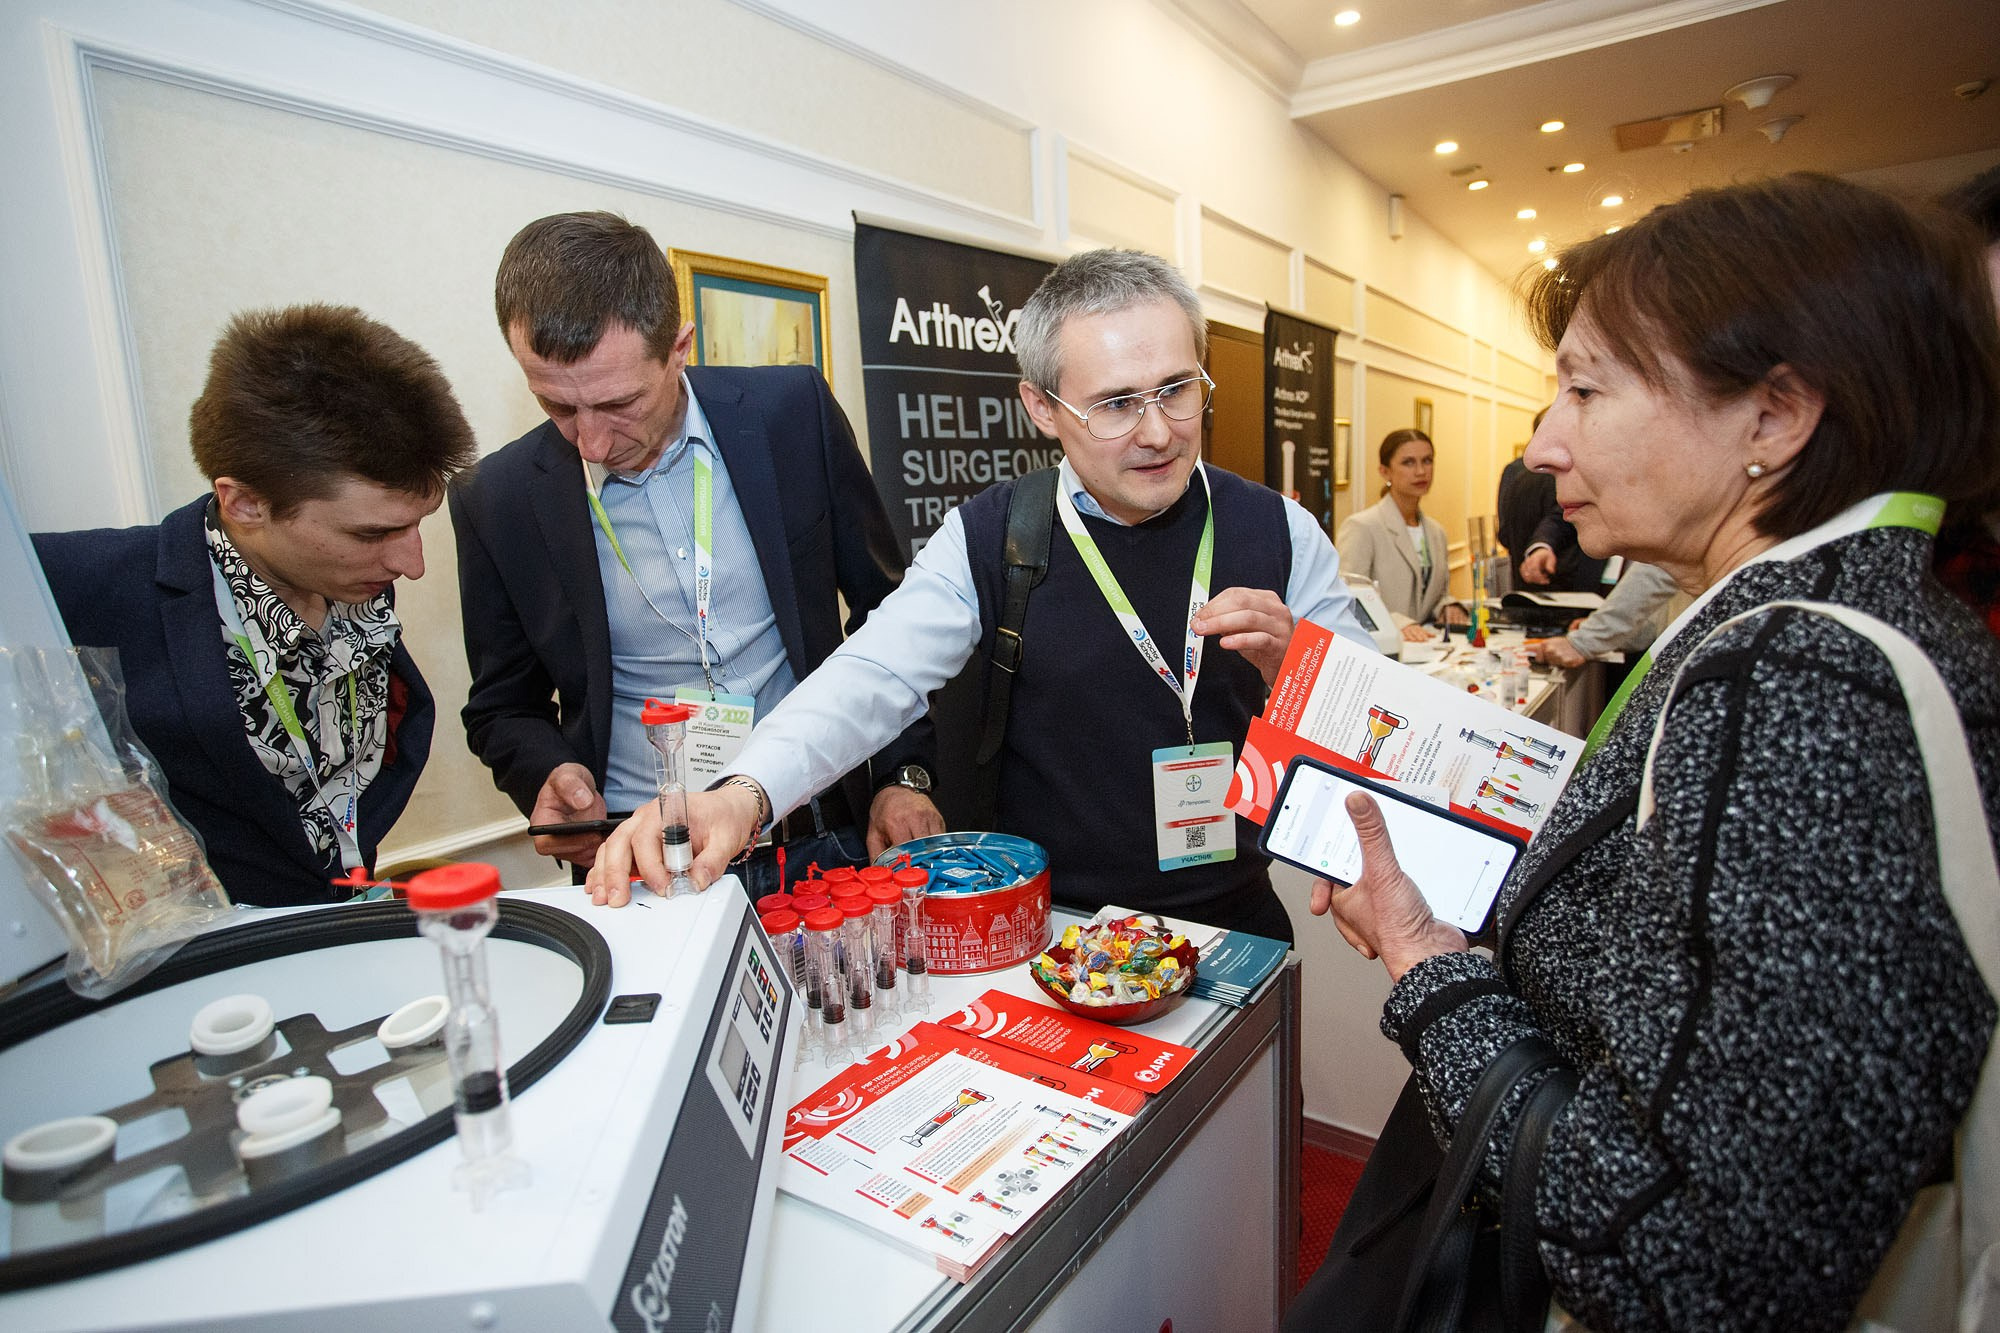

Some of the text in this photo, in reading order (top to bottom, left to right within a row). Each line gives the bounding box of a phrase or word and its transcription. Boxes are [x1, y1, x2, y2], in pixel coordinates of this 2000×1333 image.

[889, 296, 1019, 354] Arthrex
[897, 393, 1038, 439] HELPIN
[903, 449, 1064, 486] SURGEONS
[1138, 641, 1155, 663] School
[1144, 637, 1160, 659] Doctor
[1183, 646, 1193, 672] ЦИТО
[1275, 646, 1312, 728] ВНУТРЕННИЕ РЕЗЕРВЫ
[1284, 637, 1326, 732] ЗДОРОВЬЯ И МОЛОДОСТИ!
[1269, 708, 1278, 724] PRP
[1274, 674, 1292, 708] ТЕРАПИЯ
[690, 757, 724, 766] ВИКТОРОВИЧ
[1181, 852, 1213, 863] УЧАСТНИК
[872, 1064, 898, 1083] ТЕРАПИЯ
[1149, 1051, 1175, 1072] АРМ
[1081, 1087, 1104, 1101] РМ
